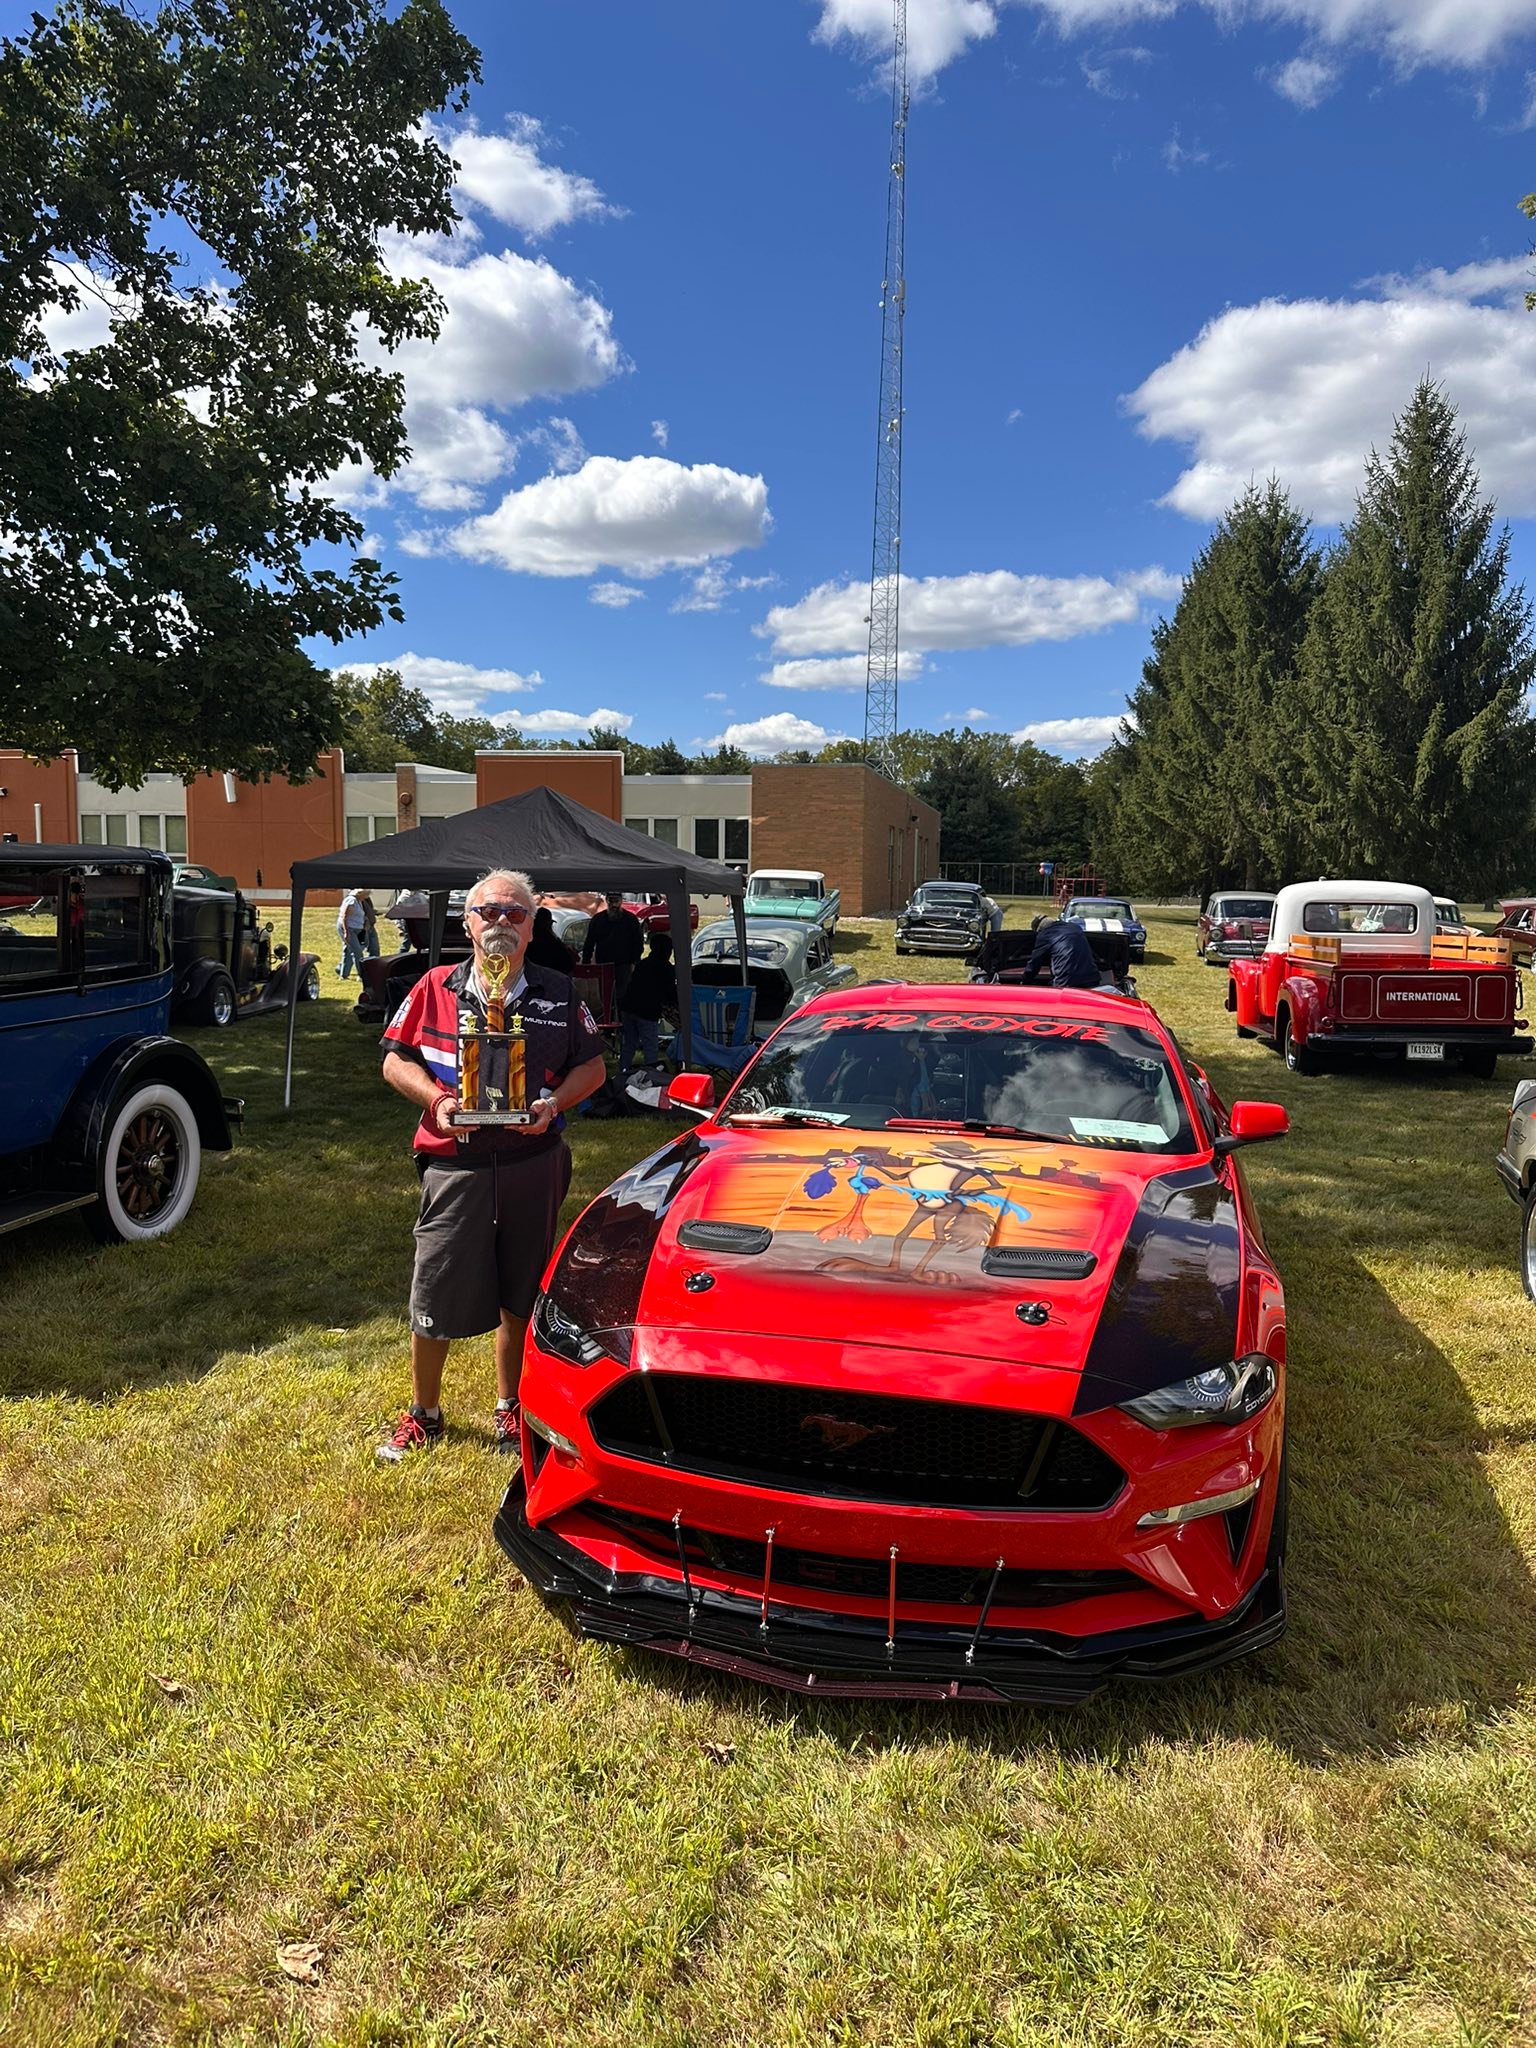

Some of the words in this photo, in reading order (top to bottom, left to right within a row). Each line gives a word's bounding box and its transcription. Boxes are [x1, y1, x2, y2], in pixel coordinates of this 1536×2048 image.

[1386, 992, 1461, 1001] INTERNATIONAL
[524, 1017, 567, 1027] MUSTANG
[820, 1014, 918, 1031] BAD
[926, 1015, 1117, 1042] COYOTE
